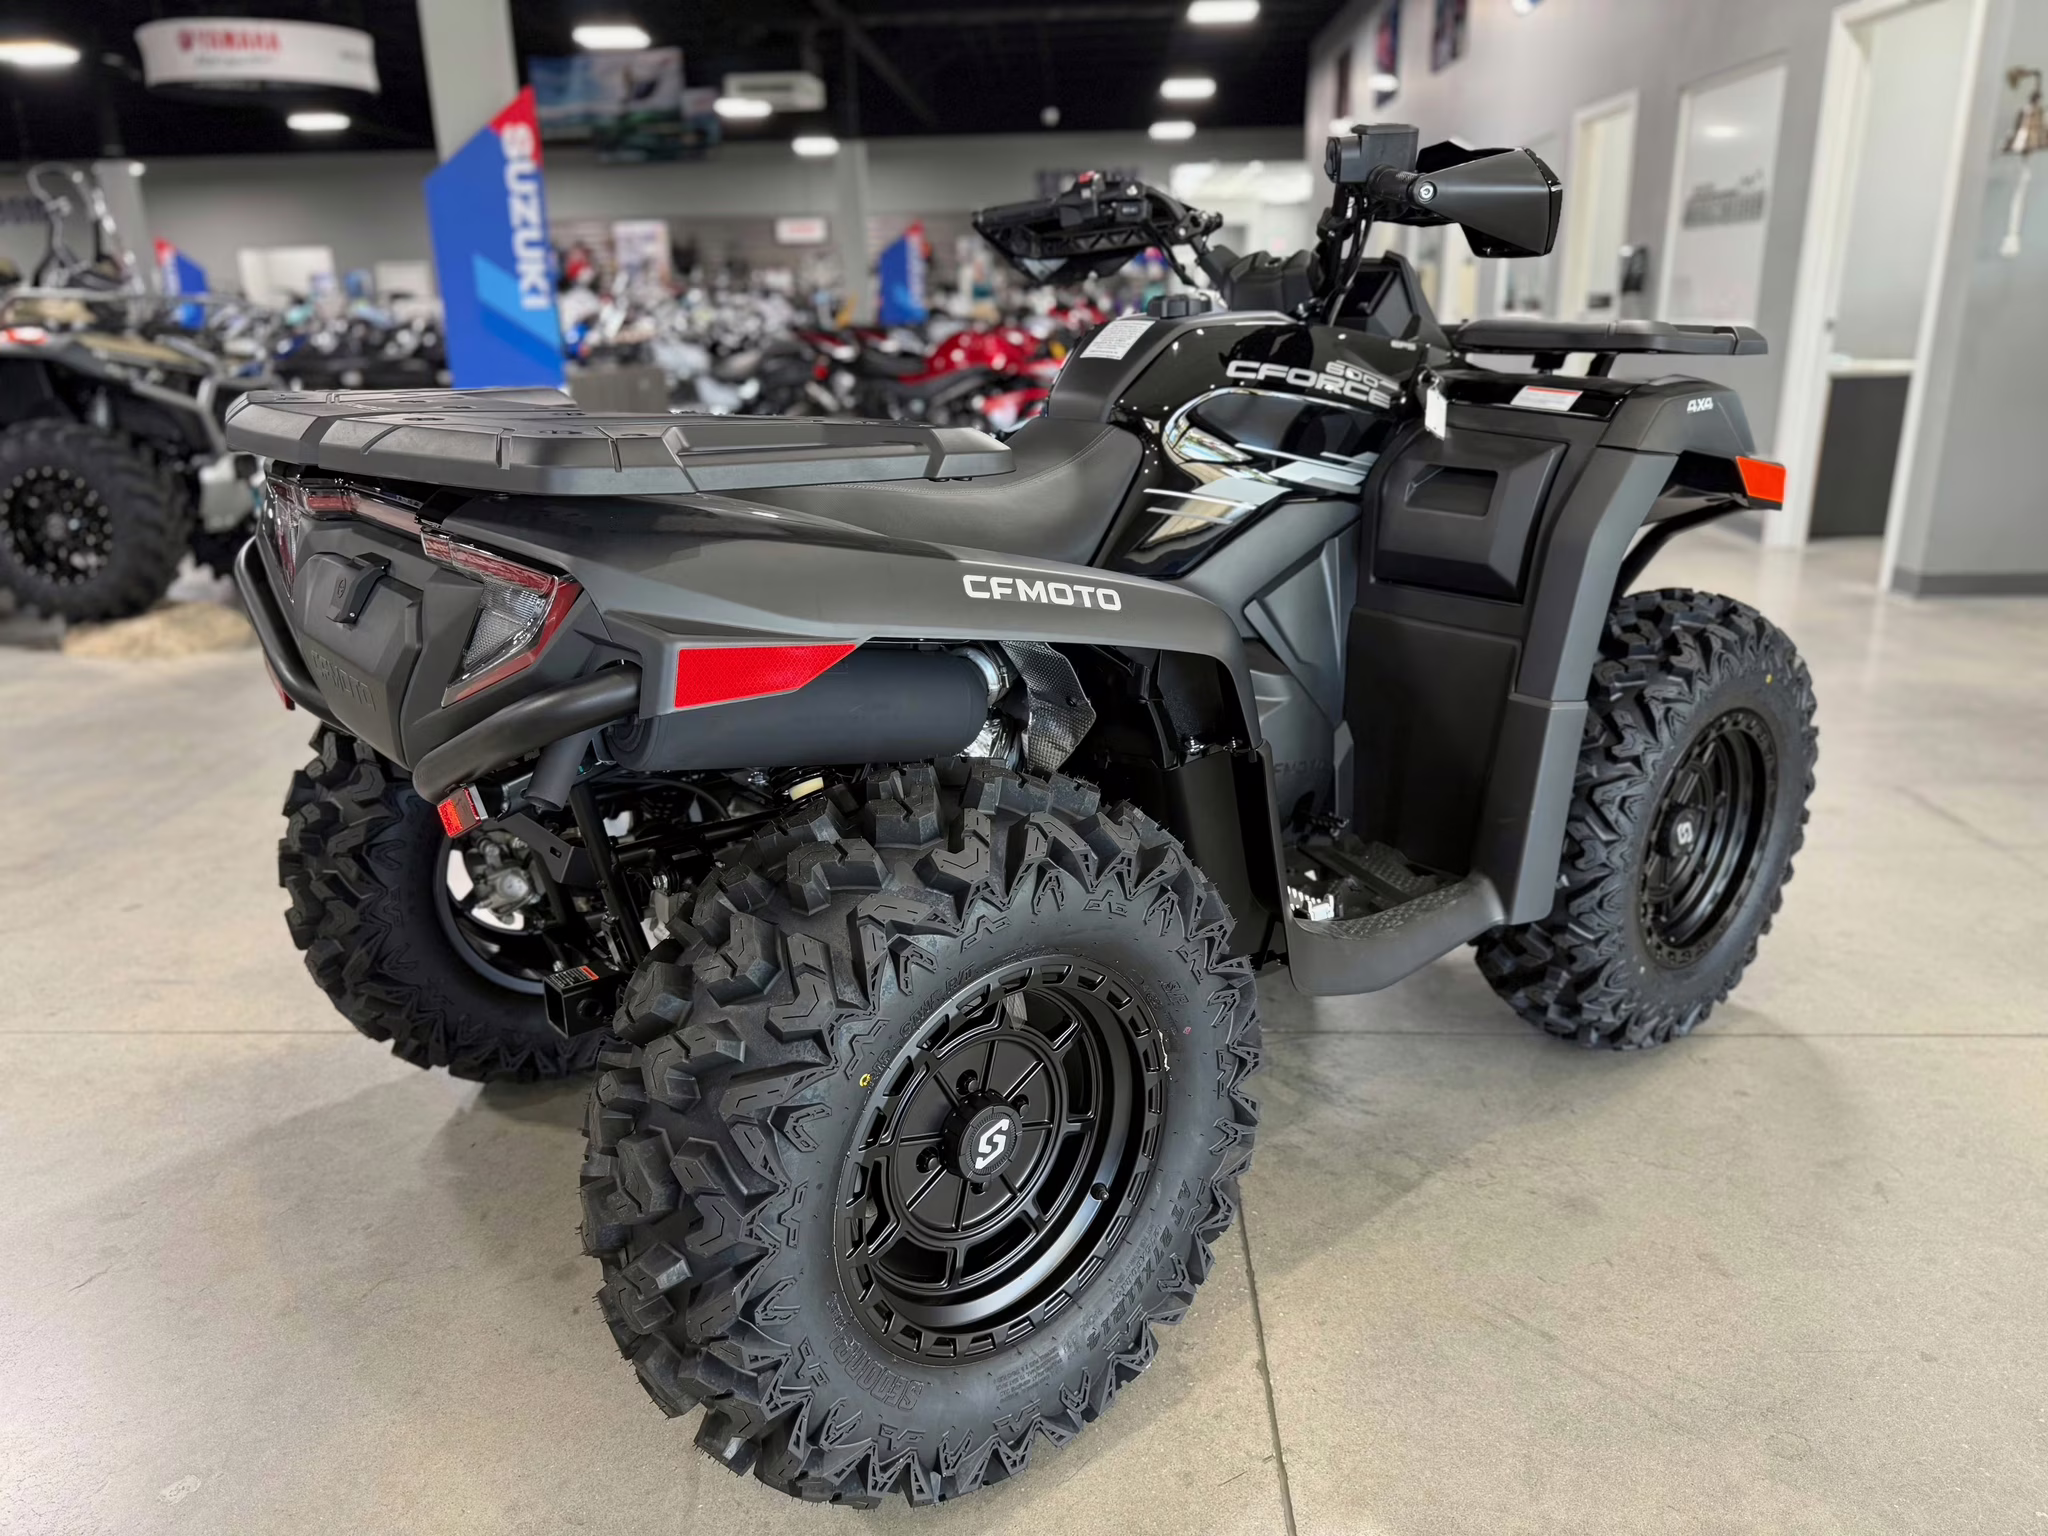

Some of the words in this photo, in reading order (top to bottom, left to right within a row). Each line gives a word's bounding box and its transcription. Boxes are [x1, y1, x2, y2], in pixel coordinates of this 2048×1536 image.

[501, 122, 551, 311] SUZUKI
[1226, 360, 1391, 409] CFORCE
[1687, 397, 1713, 413] 4X4
[963, 575, 1122, 611] CFMOTO
[827, 1332, 924, 1411] SEDONA
